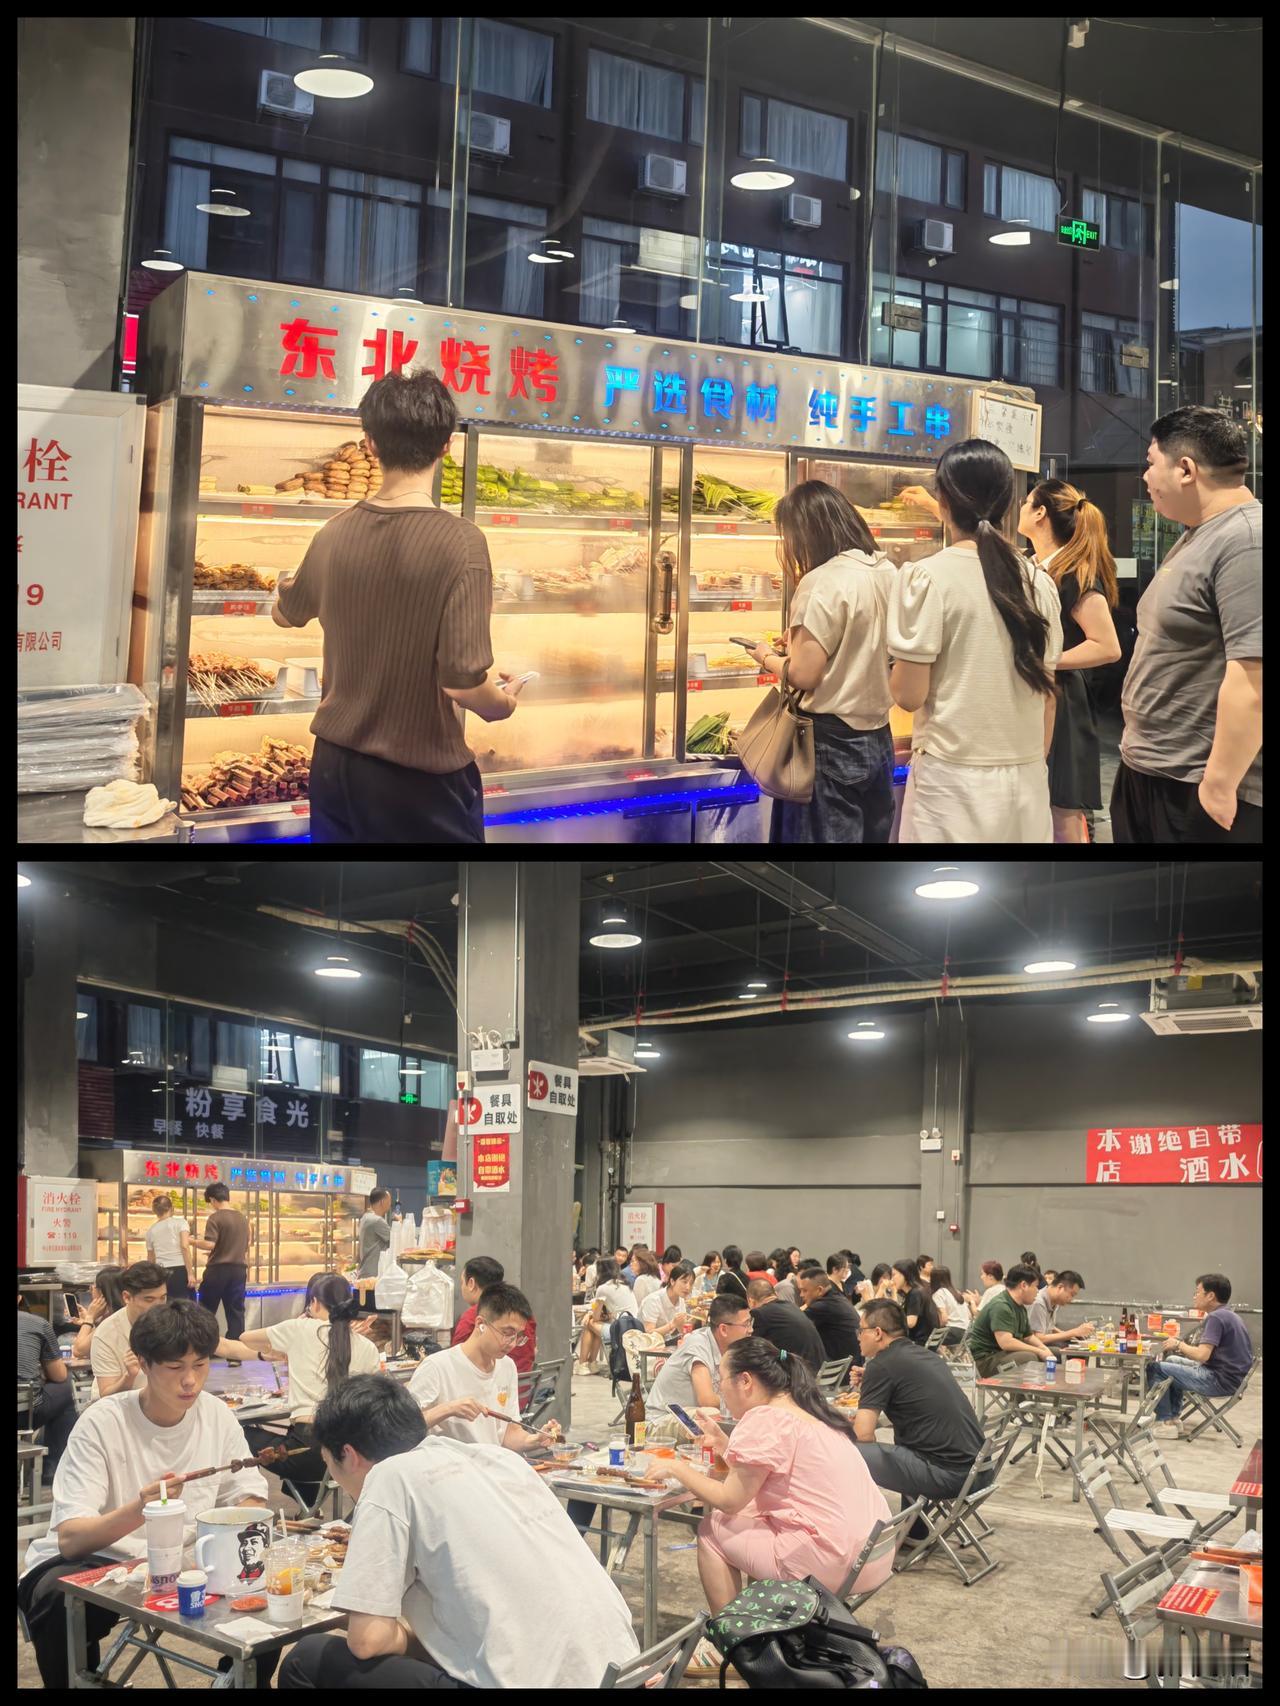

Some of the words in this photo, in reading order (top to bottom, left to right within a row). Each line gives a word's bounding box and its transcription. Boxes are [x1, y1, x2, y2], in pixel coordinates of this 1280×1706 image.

[1086, 230, 1097, 240] EXIT
[279, 318, 559, 403] 东北烧烤
[603, 364, 779, 424] 严选食材
[809, 387, 951, 440] 纯手工串
[22, 437, 72, 483] 栓
[554, 1074, 572, 1089] 餐具
[490, 1094, 512, 1108] 餐具
[550, 1091, 576, 1107] 自取处
[185, 1087, 309, 1128] 粉享食光
[484, 1112, 517, 1125] 自取处
[153, 1118, 183, 1136] 早餐
[195, 1122, 225, 1139] 快餐
[43, 1192, 81, 1205] 消火栓
